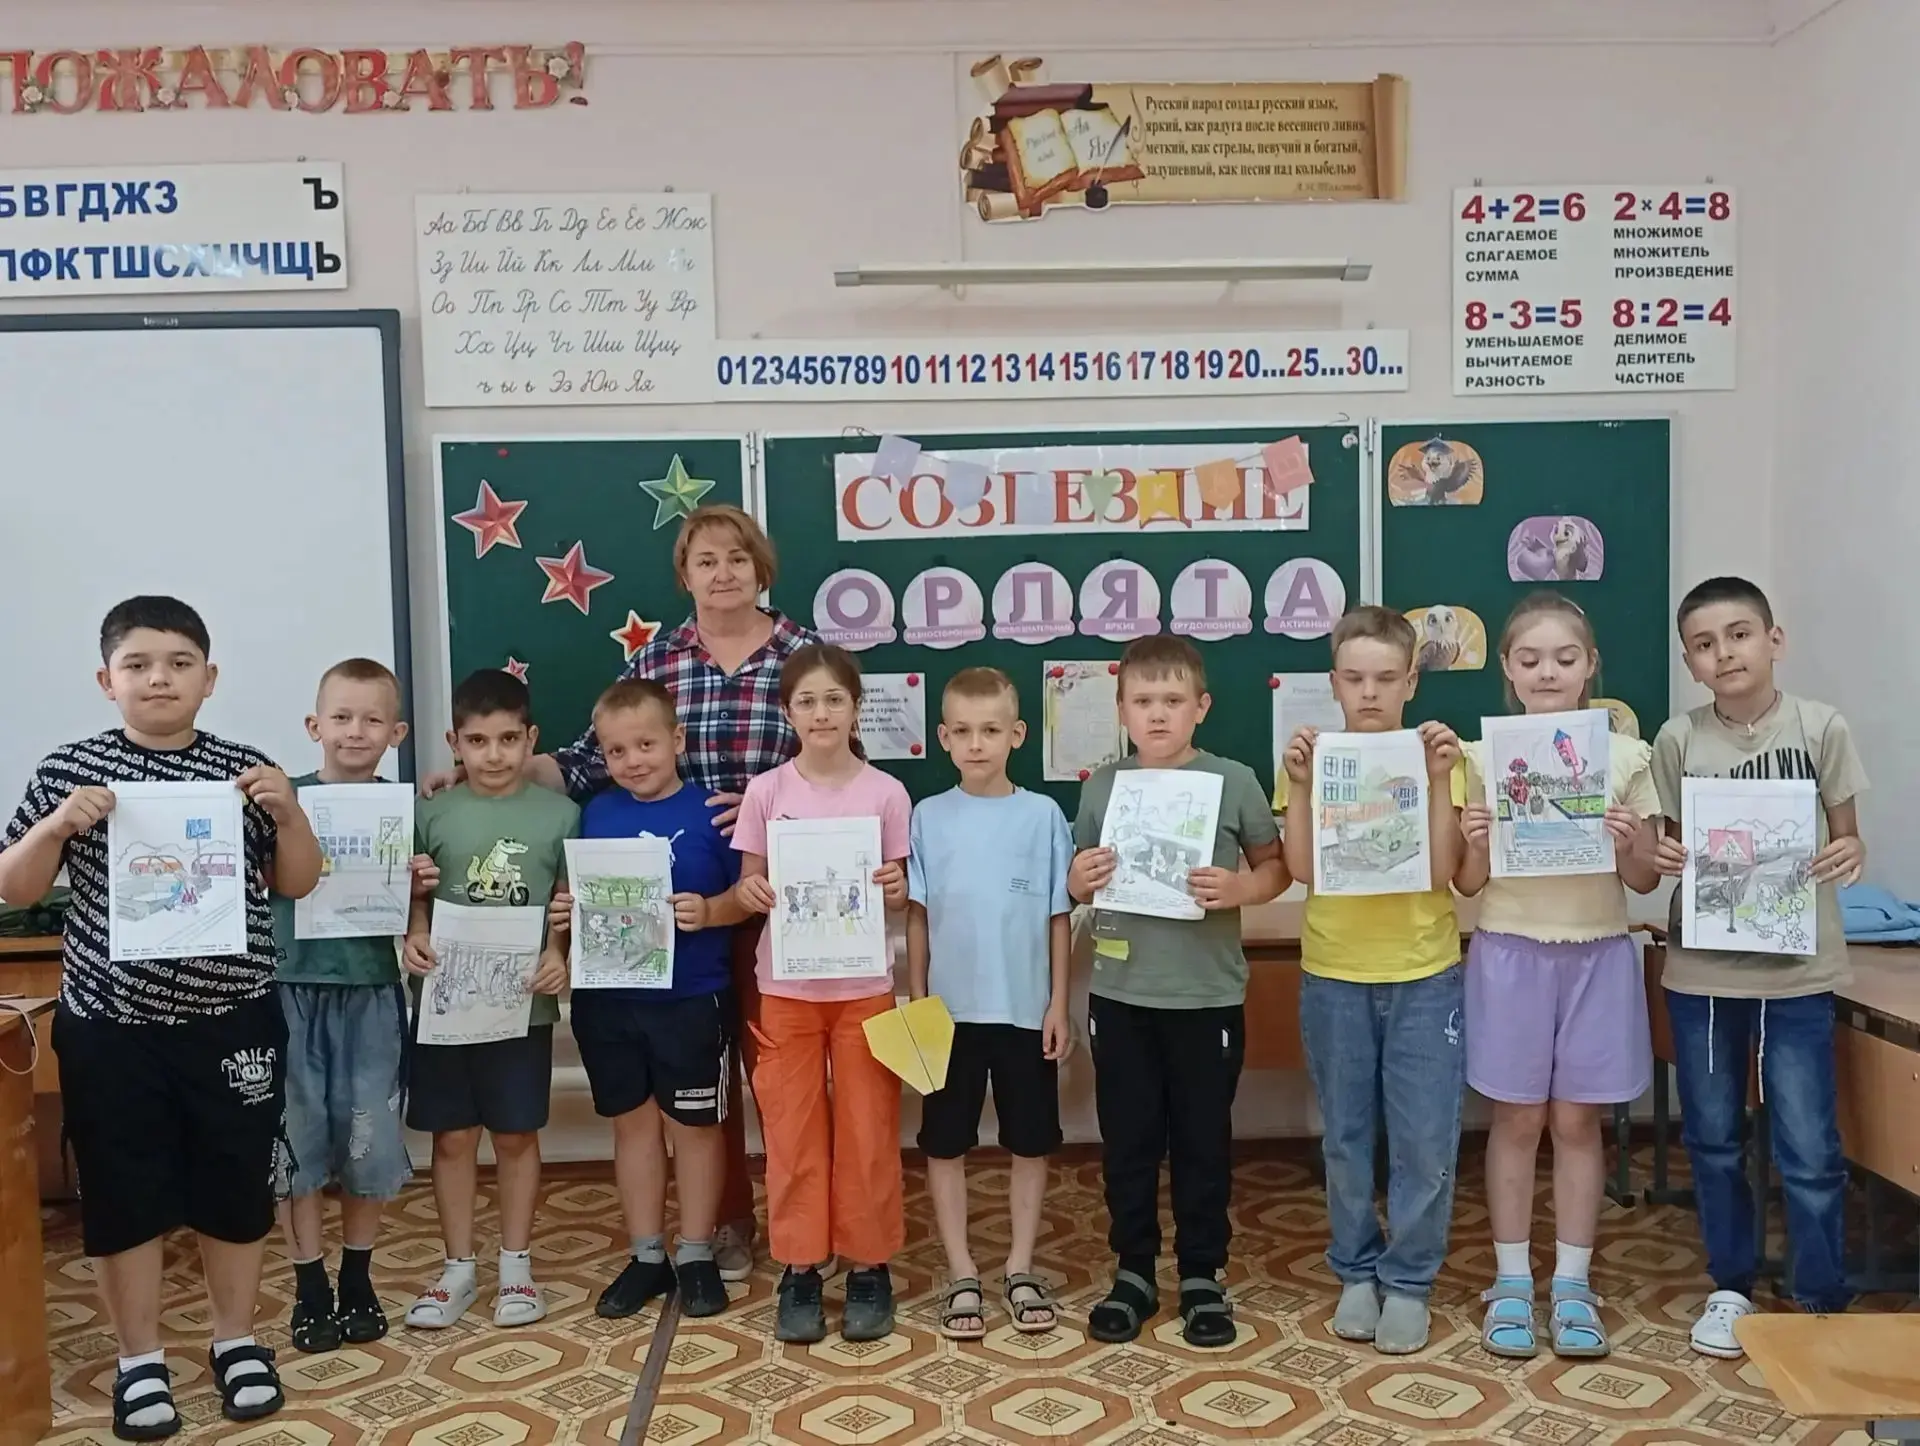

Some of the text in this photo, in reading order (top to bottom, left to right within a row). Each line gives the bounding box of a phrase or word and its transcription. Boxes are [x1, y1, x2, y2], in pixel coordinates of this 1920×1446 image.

[1145, 96, 1189, 115] Русский
[1145, 118, 1182, 135] яркий,
[1185, 120, 1204, 131] как
[1207, 120, 1243, 135] радуга
[1191, 142, 1210, 154] как
[1212, 142, 1255, 158] стрелы,
[1218, 165, 1237, 176] как
[1295, 161, 1357, 176] колыбелью
[0, 177, 339, 223] БВГДЖЗ Ъ
[1461, 191, 1587, 224] 4+2=6
[424, 211, 457, 235] Аа
[462, 208, 497, 233] Бб
[496, 209, 524, 233] Вв
[528, 207, 553, 232] Гг
[559, 208, 590, 240] Дд
[596, 207, 618, 231] Ее
[652, 207, 708, 232] Жж
[1465, 229, 1558, 243] СЛАГАЕМОЕ
[1613, 226, 1703, 239] МНОЖИМОЕ
[1465, 248, 1558, 263] СЛАГАЕМОЕ
[1613, 246, 1710, 259] МНОЖИТЕЛЬ
[430, 250, 454, 284] Зз
[459, 250, 490, 274] Ии
[496, 246, 526, 273] Йй
[533, 249, 564, 273] Кк
[572, 249, 603, 273] Лл
[607, 249, 656, 273] Мм
[1614, 265, 1734, 280] ПРОИЗВЕДЕНИЕ
[1465, 269, 1520, 282] СУММА
[431, 291, 456, 315] Оо
[467, 289, 505, 315] Пп
[511, 289, 541, 323] Рр
[548, 289, 572, 314] Сс
[578, 289, 627, 314] Тт
[634, 289, 660, 321] Уу
[1612, 297, 1732, 328] 8:2=4
[1464, 299, 1583, 331] 8-3=5
[454, 329, 682, 360] Хх Цц Чч Шш Щщ
[1465, 335, 1584, 349] УМЕНЬШАЕМОЕ
[1614, 333, 1688, 347] ДЕЛИМОЕ
[717, 355, 887, 385] 0123456789
[890, 354, 921, 384] 10
[925, 354, 950, 384] 11
[956, 353, 987, 383] 12
[991, 353, 1021, 382] 13
[1026, 352, 1055, 382] 14
[1059, 351, 1089, 381] 15
[1092, 351, 1122, 381] 16
[1127, 351, 1156, 380] 17
[1161, 350, 1190, 380] 18
[1194, 349, 1223, 379] 19
[1465, 354, 1573, 369] ВЫЧИТАЕМОЕ
[1615, 352, 1696, 367] ДЕЛИТЕЛЬ
[549, 370, 573, 394] Ээ
[580, 370, 619, 394] Юю
[625, 369, 656, 394] Яя
[1465, 374, 1546, 388] РАЗНОСТЬ
[1615, 372, 1686, 385] ЧАСТНОЕ
